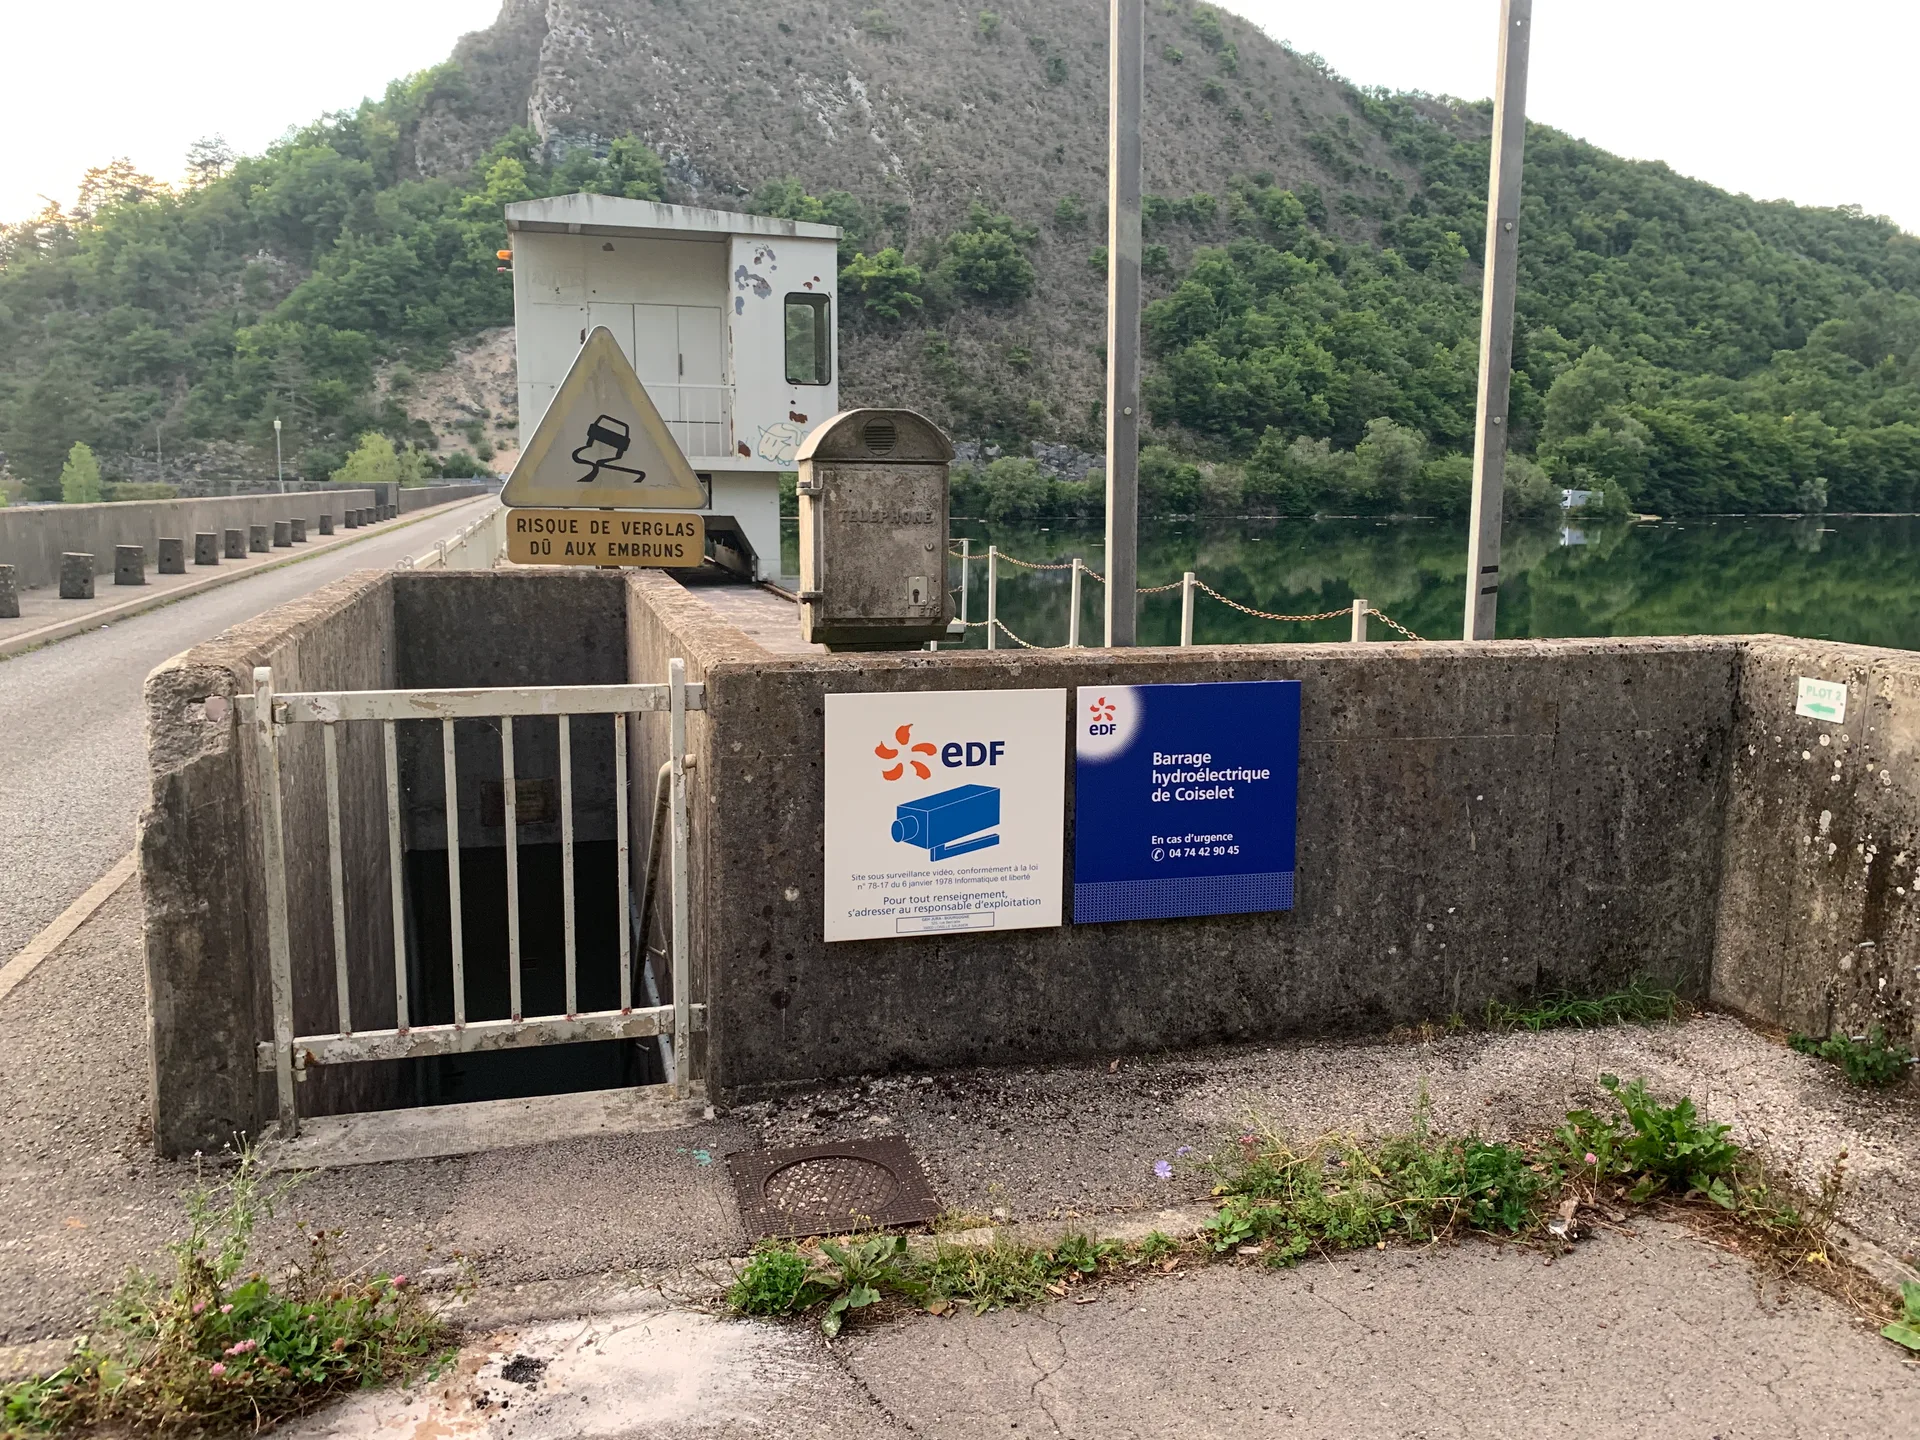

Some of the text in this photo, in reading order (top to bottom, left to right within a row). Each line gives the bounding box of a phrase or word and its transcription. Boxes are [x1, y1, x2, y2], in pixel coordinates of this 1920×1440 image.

[517, 518, 695, 537] RISQUE DE VERGLAS
[530, 539, 684, 558] DÛ AUX EMBRUNS
[1806, 685, 1842, 701] PLOT 2
[1153, 752, 1212, 767] Barrage
[1152, 766, 1270, 787] hydroélectrique
[1151, 785, 1235, 802] de Coiselet
[1151, 832, 1234, 845] En cas d'urgence
[1169, 845, 1240, 858] 04 74 42 90 45
[851, 873, 866, 881] Site
[886, 870, 931, 879] surveillance
[932, 868, 955, 876] vidéo,
[957, 865, 1012, 875] conformément
[1014, 864, 1019, 872] à
[1020, 864, 1027, 872] la
[1028, 863, 1039, 871] loi
[857, 882, 866, 890] n°
[868, 881, 889, 890] 78-17
[890, 880, 900, 888] du
[908, 879, 933, 889] janvier
[935, 877, 953, 886] 1978
[955, 874, 999, 884] Informatique
[1009, 873, 1031, 881] liberté
[883, 890, 1008, 905] Pour tout renseignement,
[848, 897, 1042, 917] s'adresser au responsable d'exploitation
